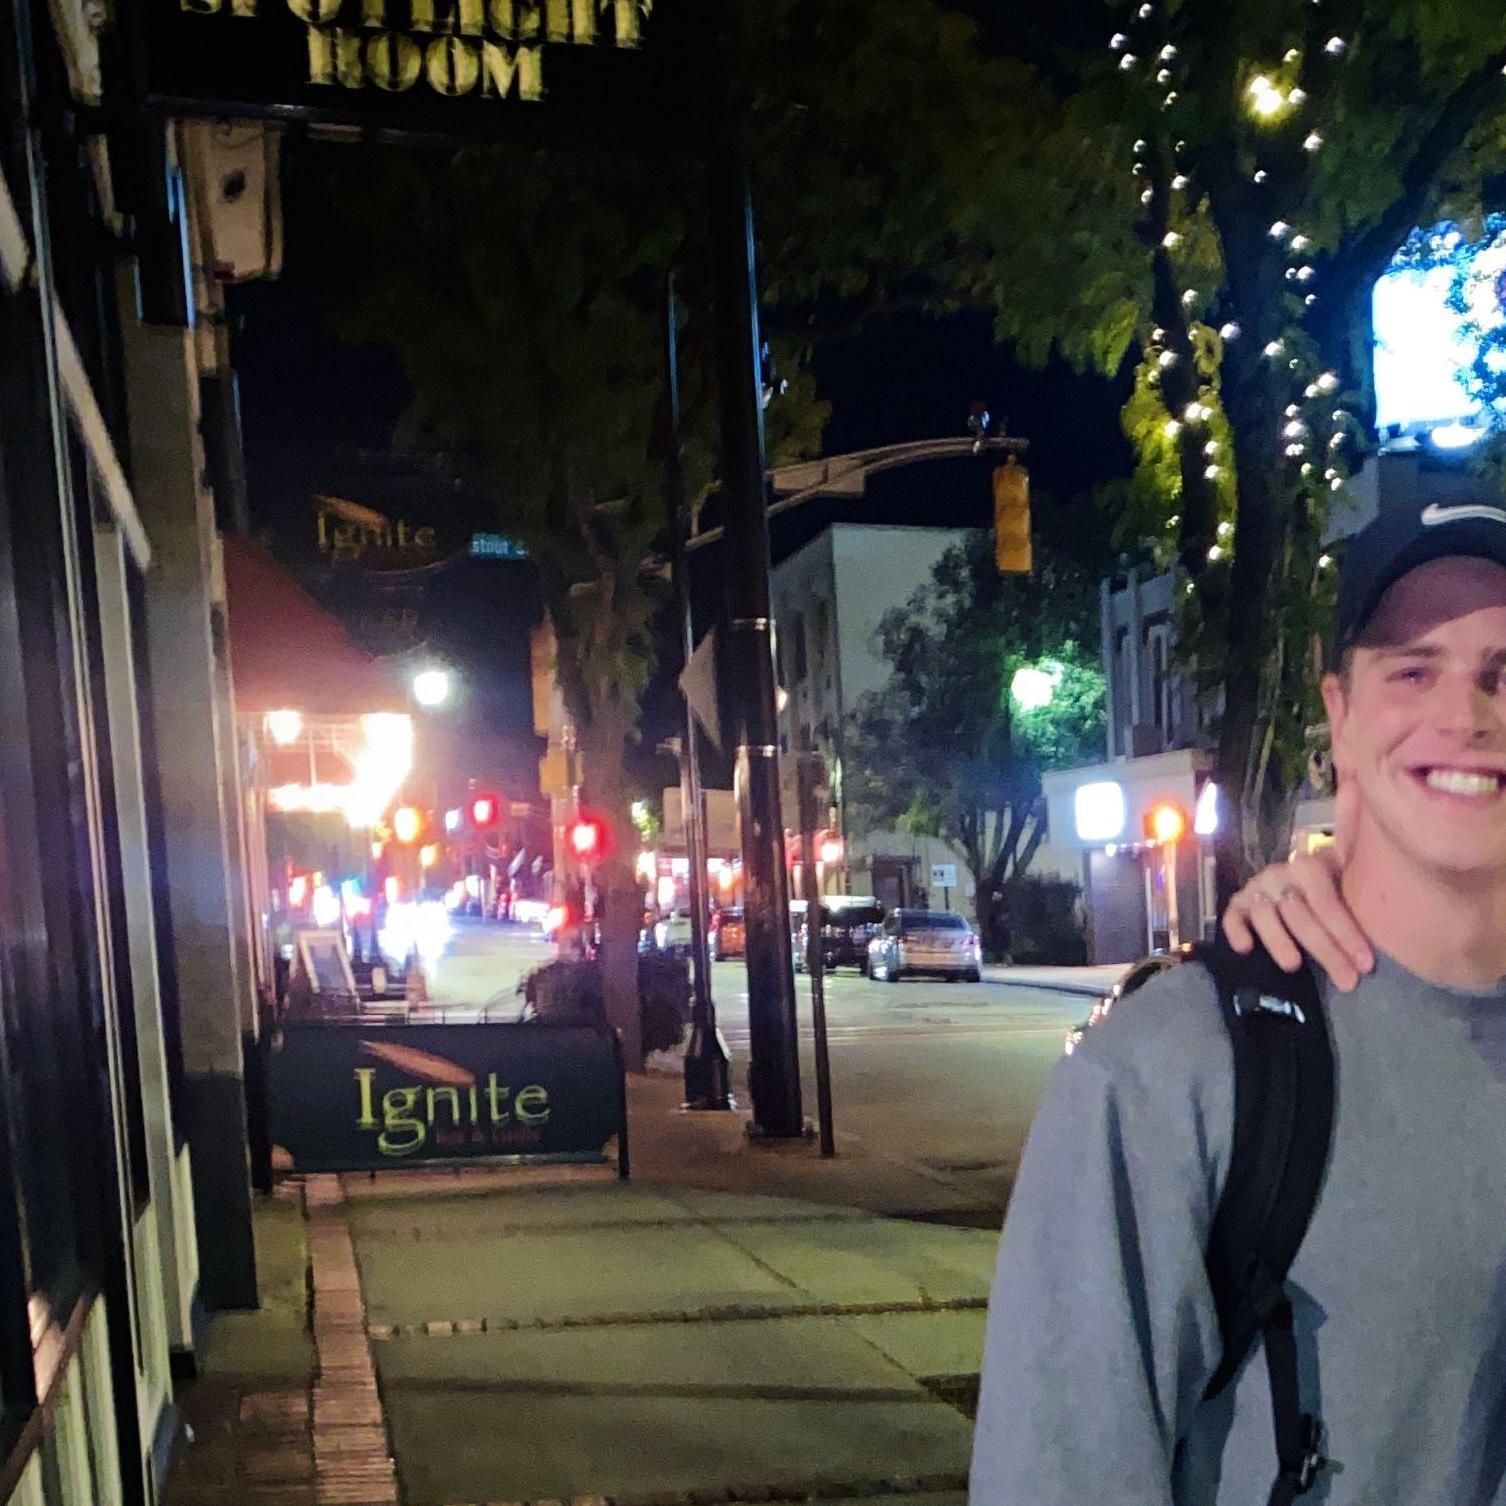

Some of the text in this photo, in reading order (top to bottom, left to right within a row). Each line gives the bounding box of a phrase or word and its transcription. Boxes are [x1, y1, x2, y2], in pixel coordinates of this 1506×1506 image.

[305, 25, 547, 101] ROOM
[316, 509, 436, 563] Ignite
[354, 1067, 550, 1155] Ignite
